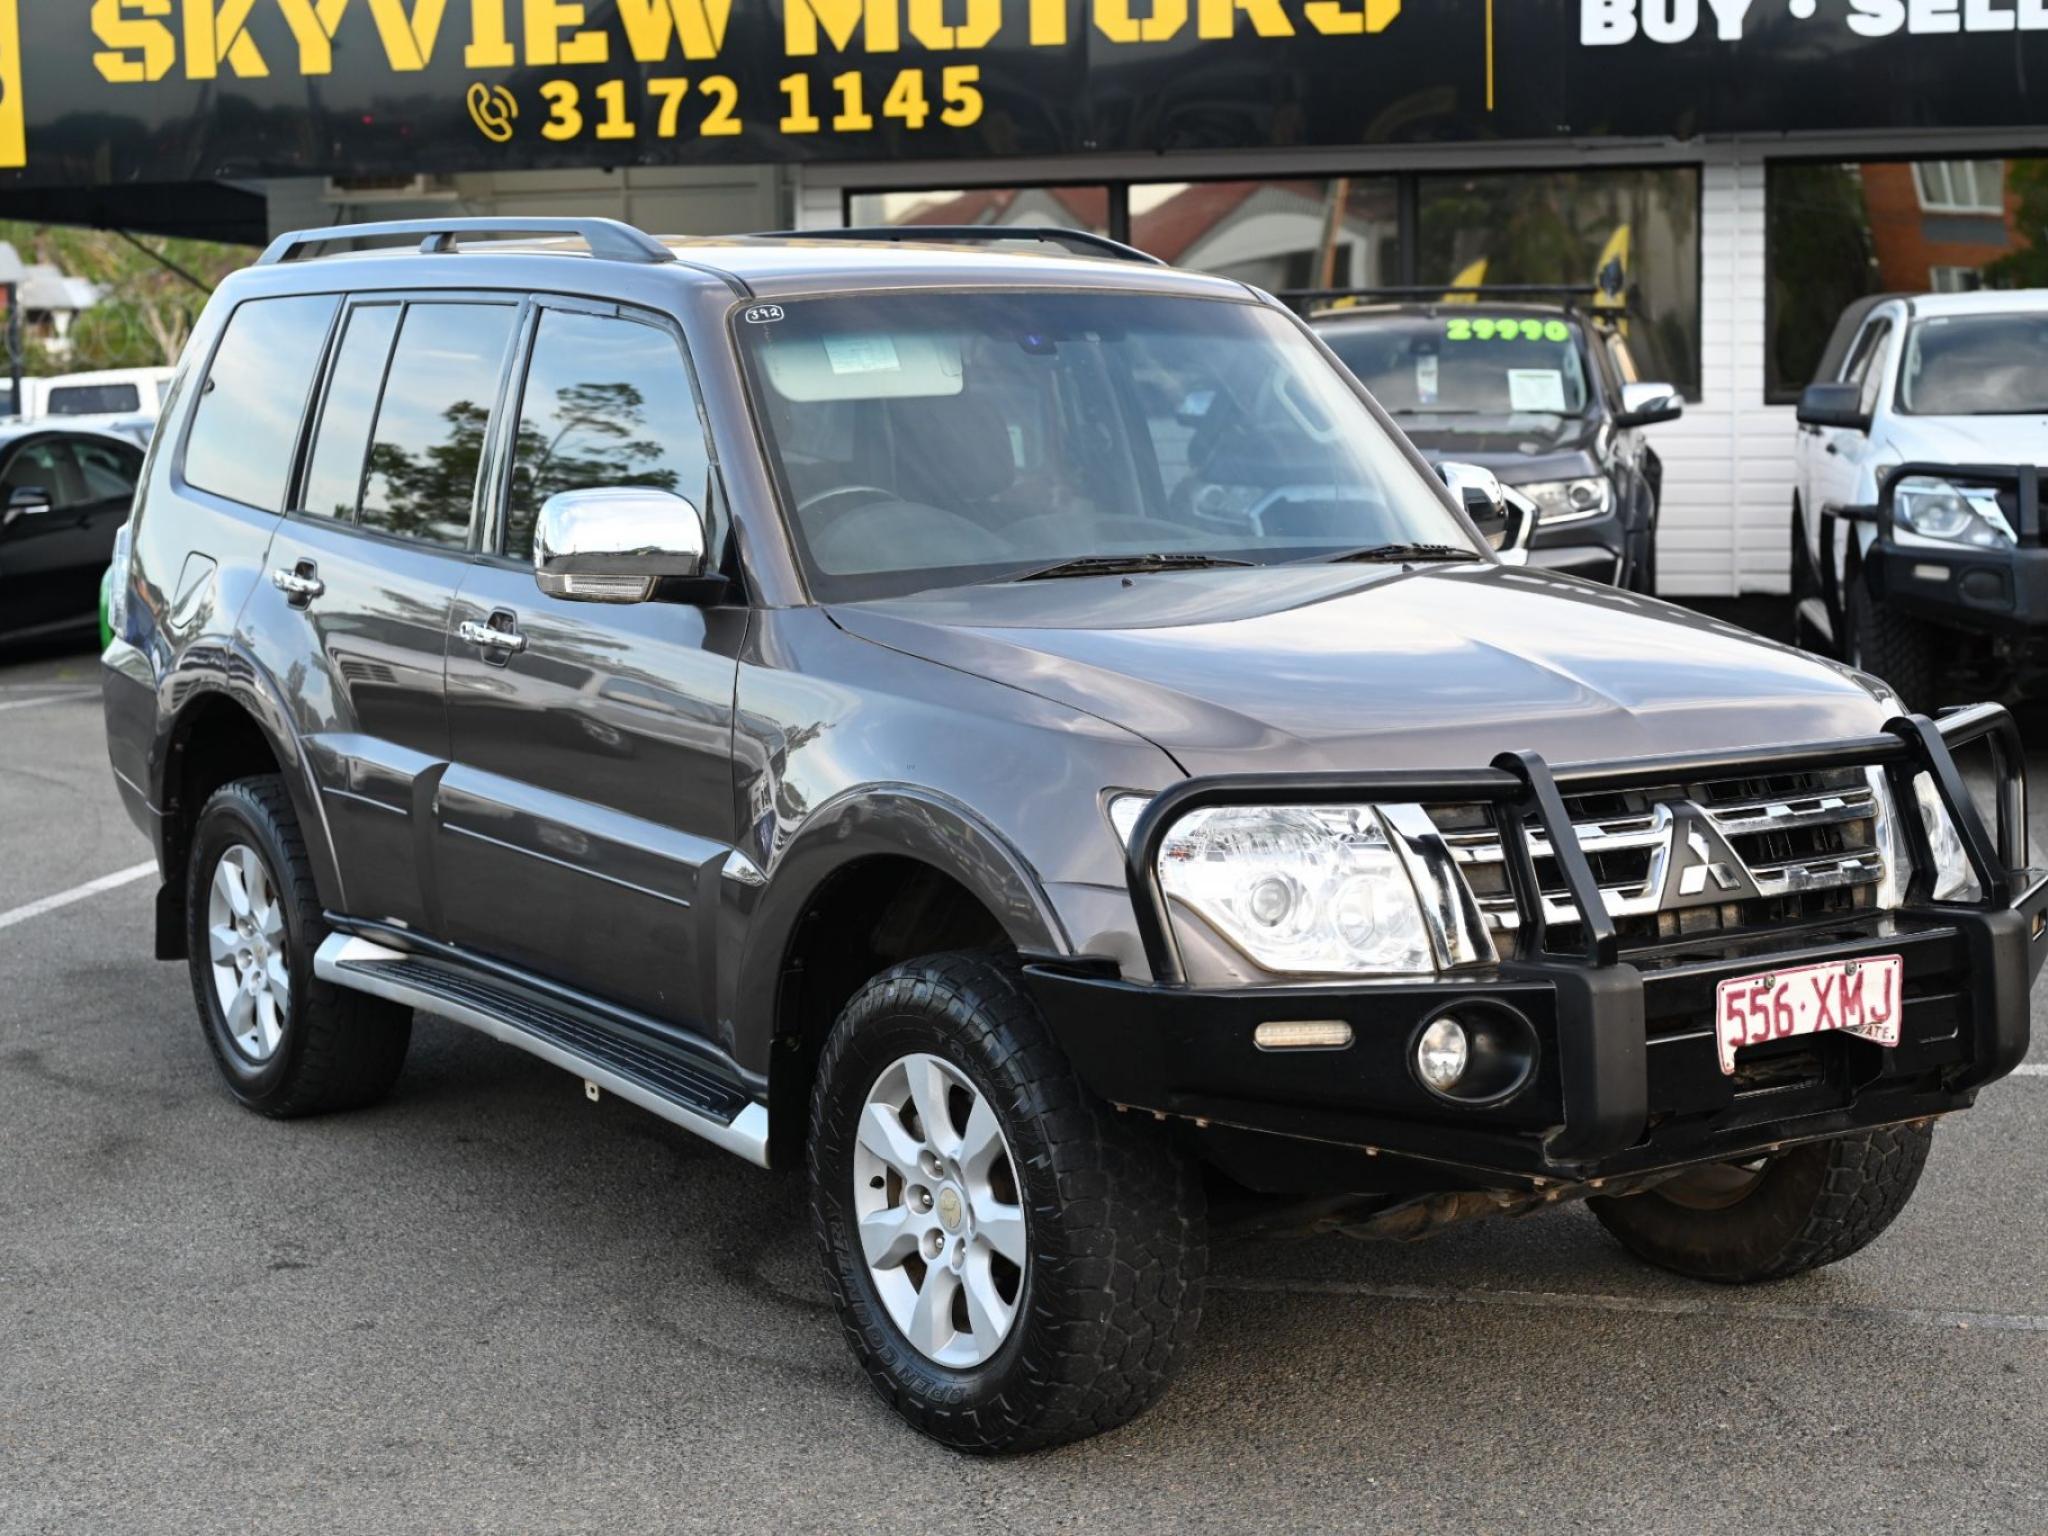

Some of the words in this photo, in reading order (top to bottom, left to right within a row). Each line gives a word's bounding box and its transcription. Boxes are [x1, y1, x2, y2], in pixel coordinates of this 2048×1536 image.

[90, 0, 733, 83] SKYVIEW
[1579, 0, 1754, 46] BUY
[538, 75, 743, 141] 3172
[779, 65, 984, 134] 1145
[750, 307, 781, 321] 392
[1446, 318, 1570, 342] 29990
[897, 1363, 966, 1406] OPEN
